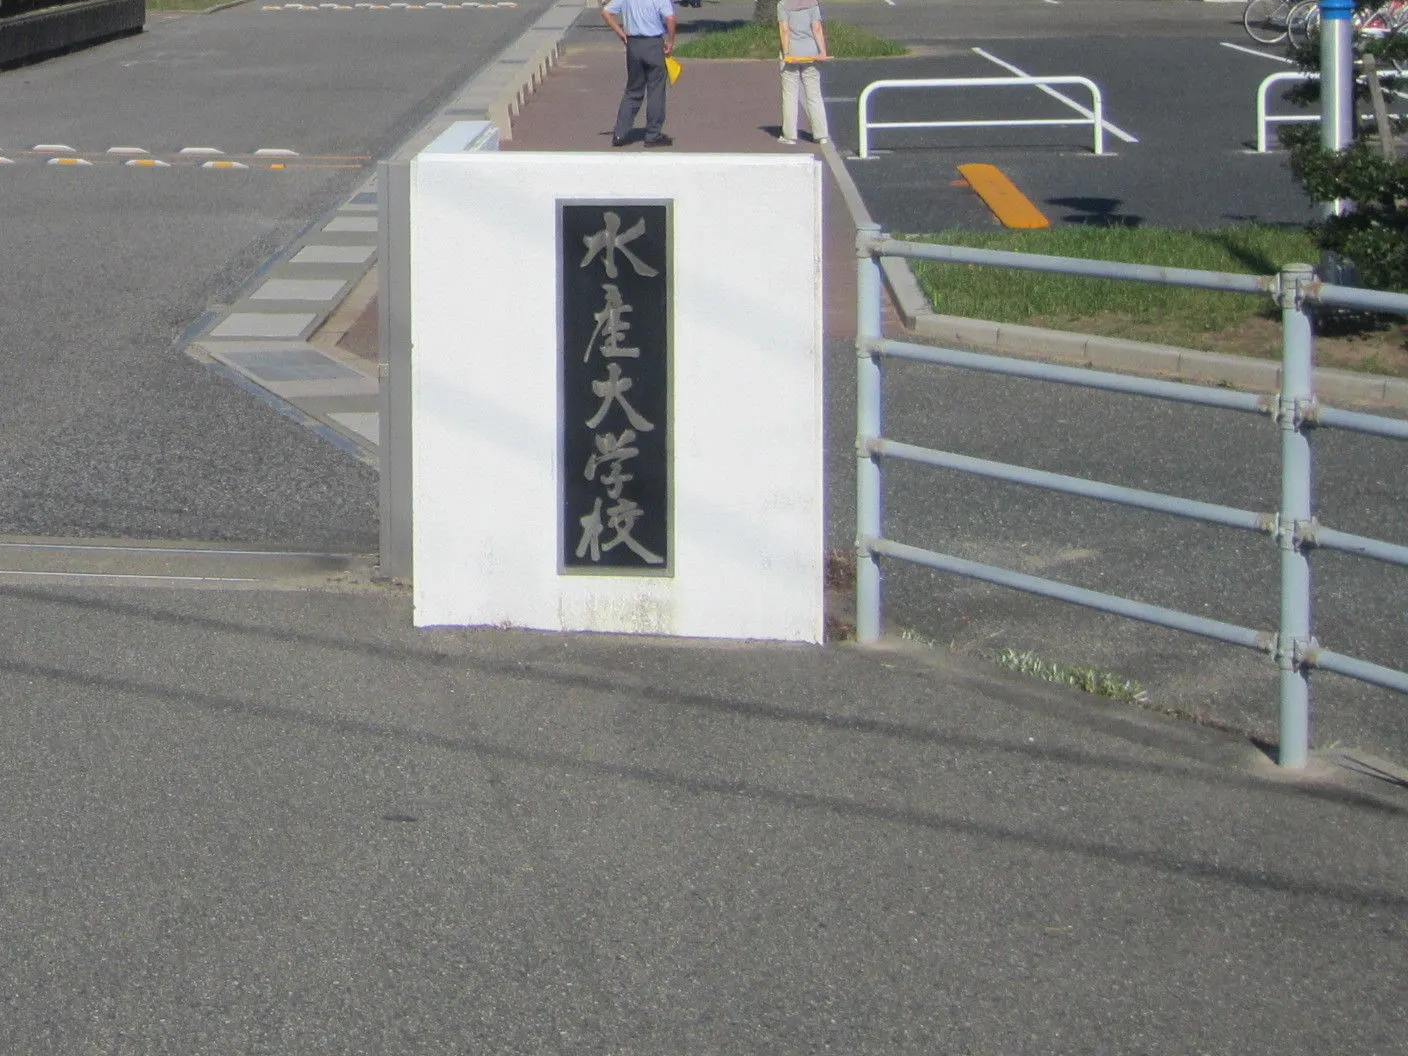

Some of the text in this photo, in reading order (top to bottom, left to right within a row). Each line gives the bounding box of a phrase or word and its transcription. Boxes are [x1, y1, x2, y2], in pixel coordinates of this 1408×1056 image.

[574, 211, 664, 564] 水産大学校
